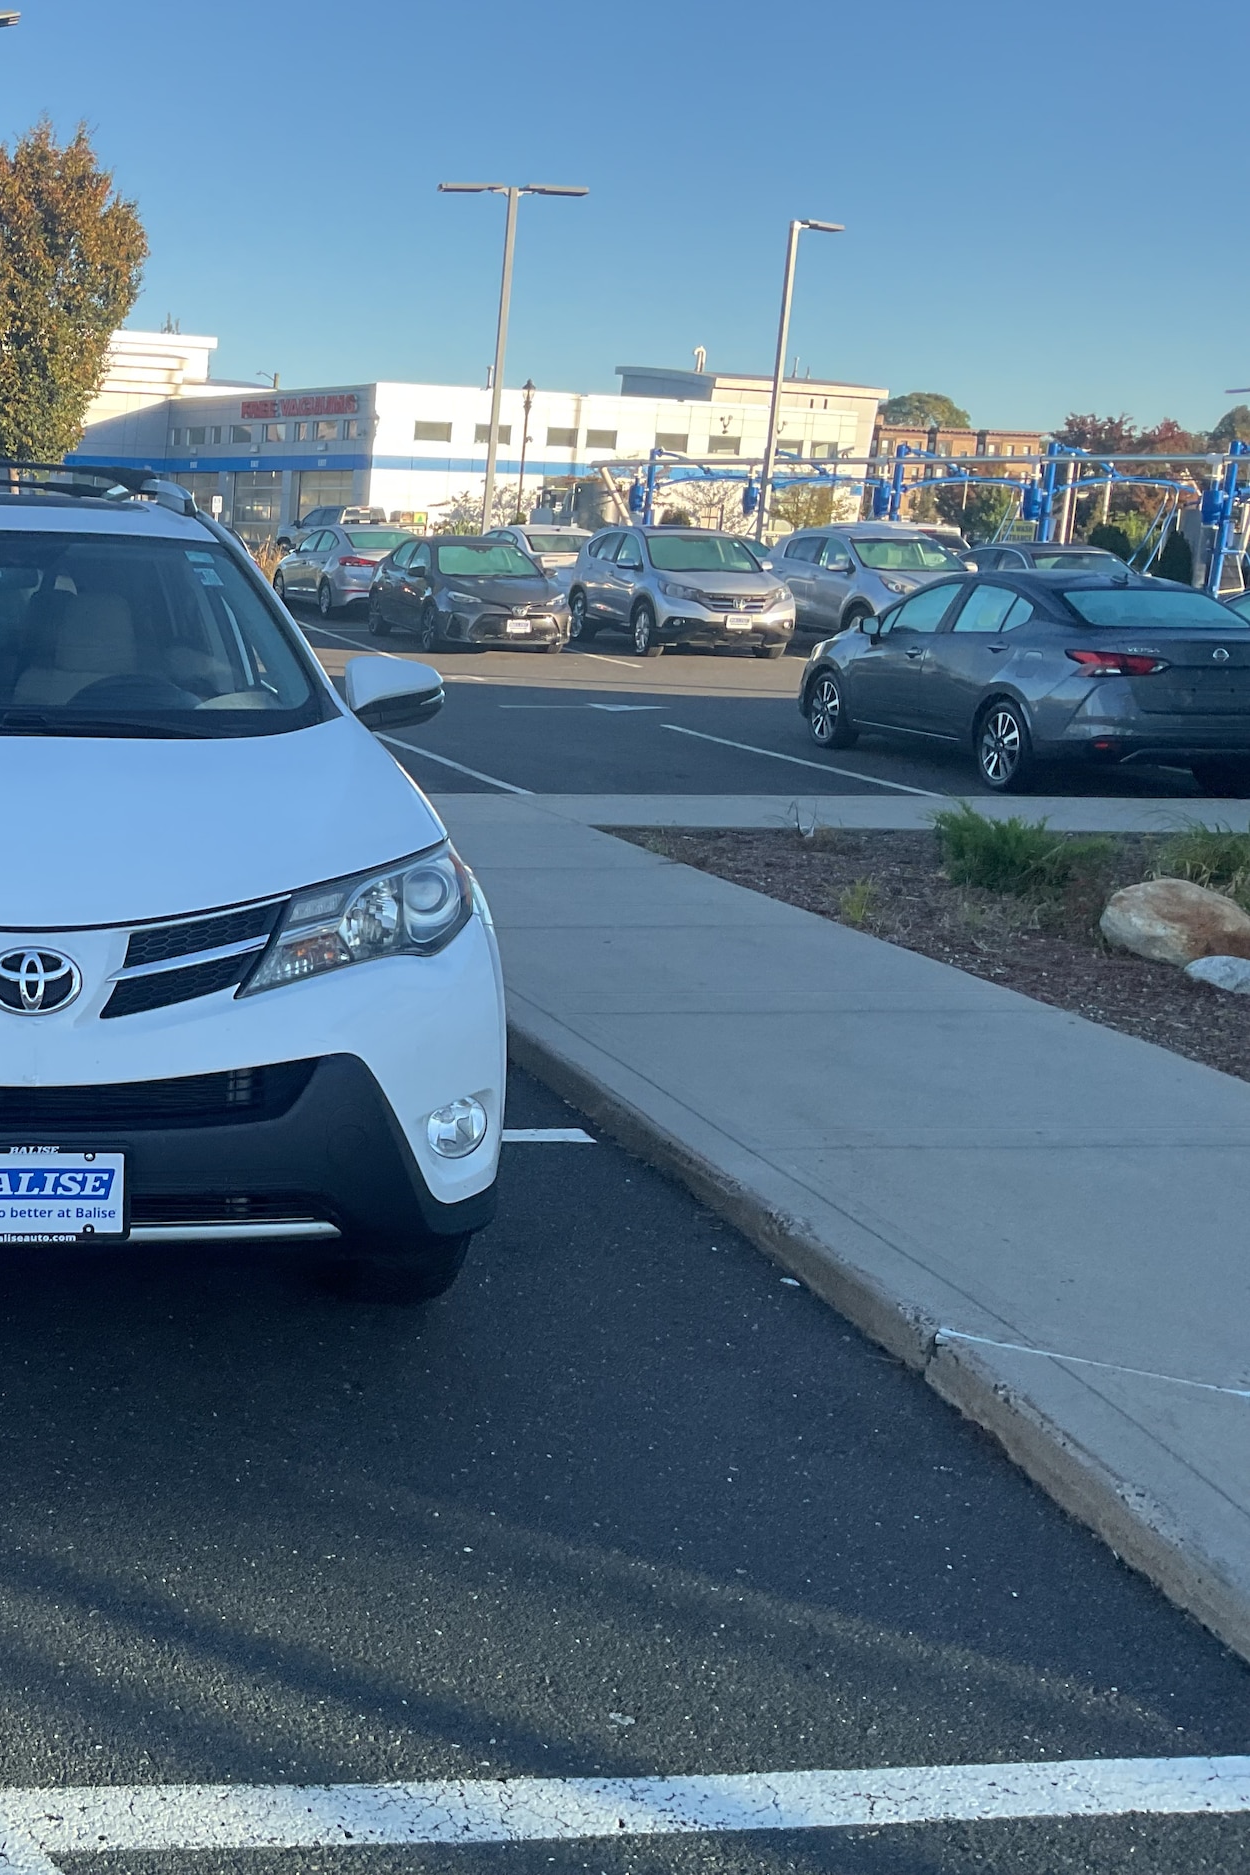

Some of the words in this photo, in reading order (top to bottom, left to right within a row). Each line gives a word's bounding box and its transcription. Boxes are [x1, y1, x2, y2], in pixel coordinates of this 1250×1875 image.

[241, 400, 278, 418] FREE
[280, 394, 358, 417] VACUUMS
[9, 1146, 60, 1155] BALISE
[10, 1207, 53, 1218] better
[57, 1208, 72, 1218] at
[75, 1207, 116, 1218] Balise
